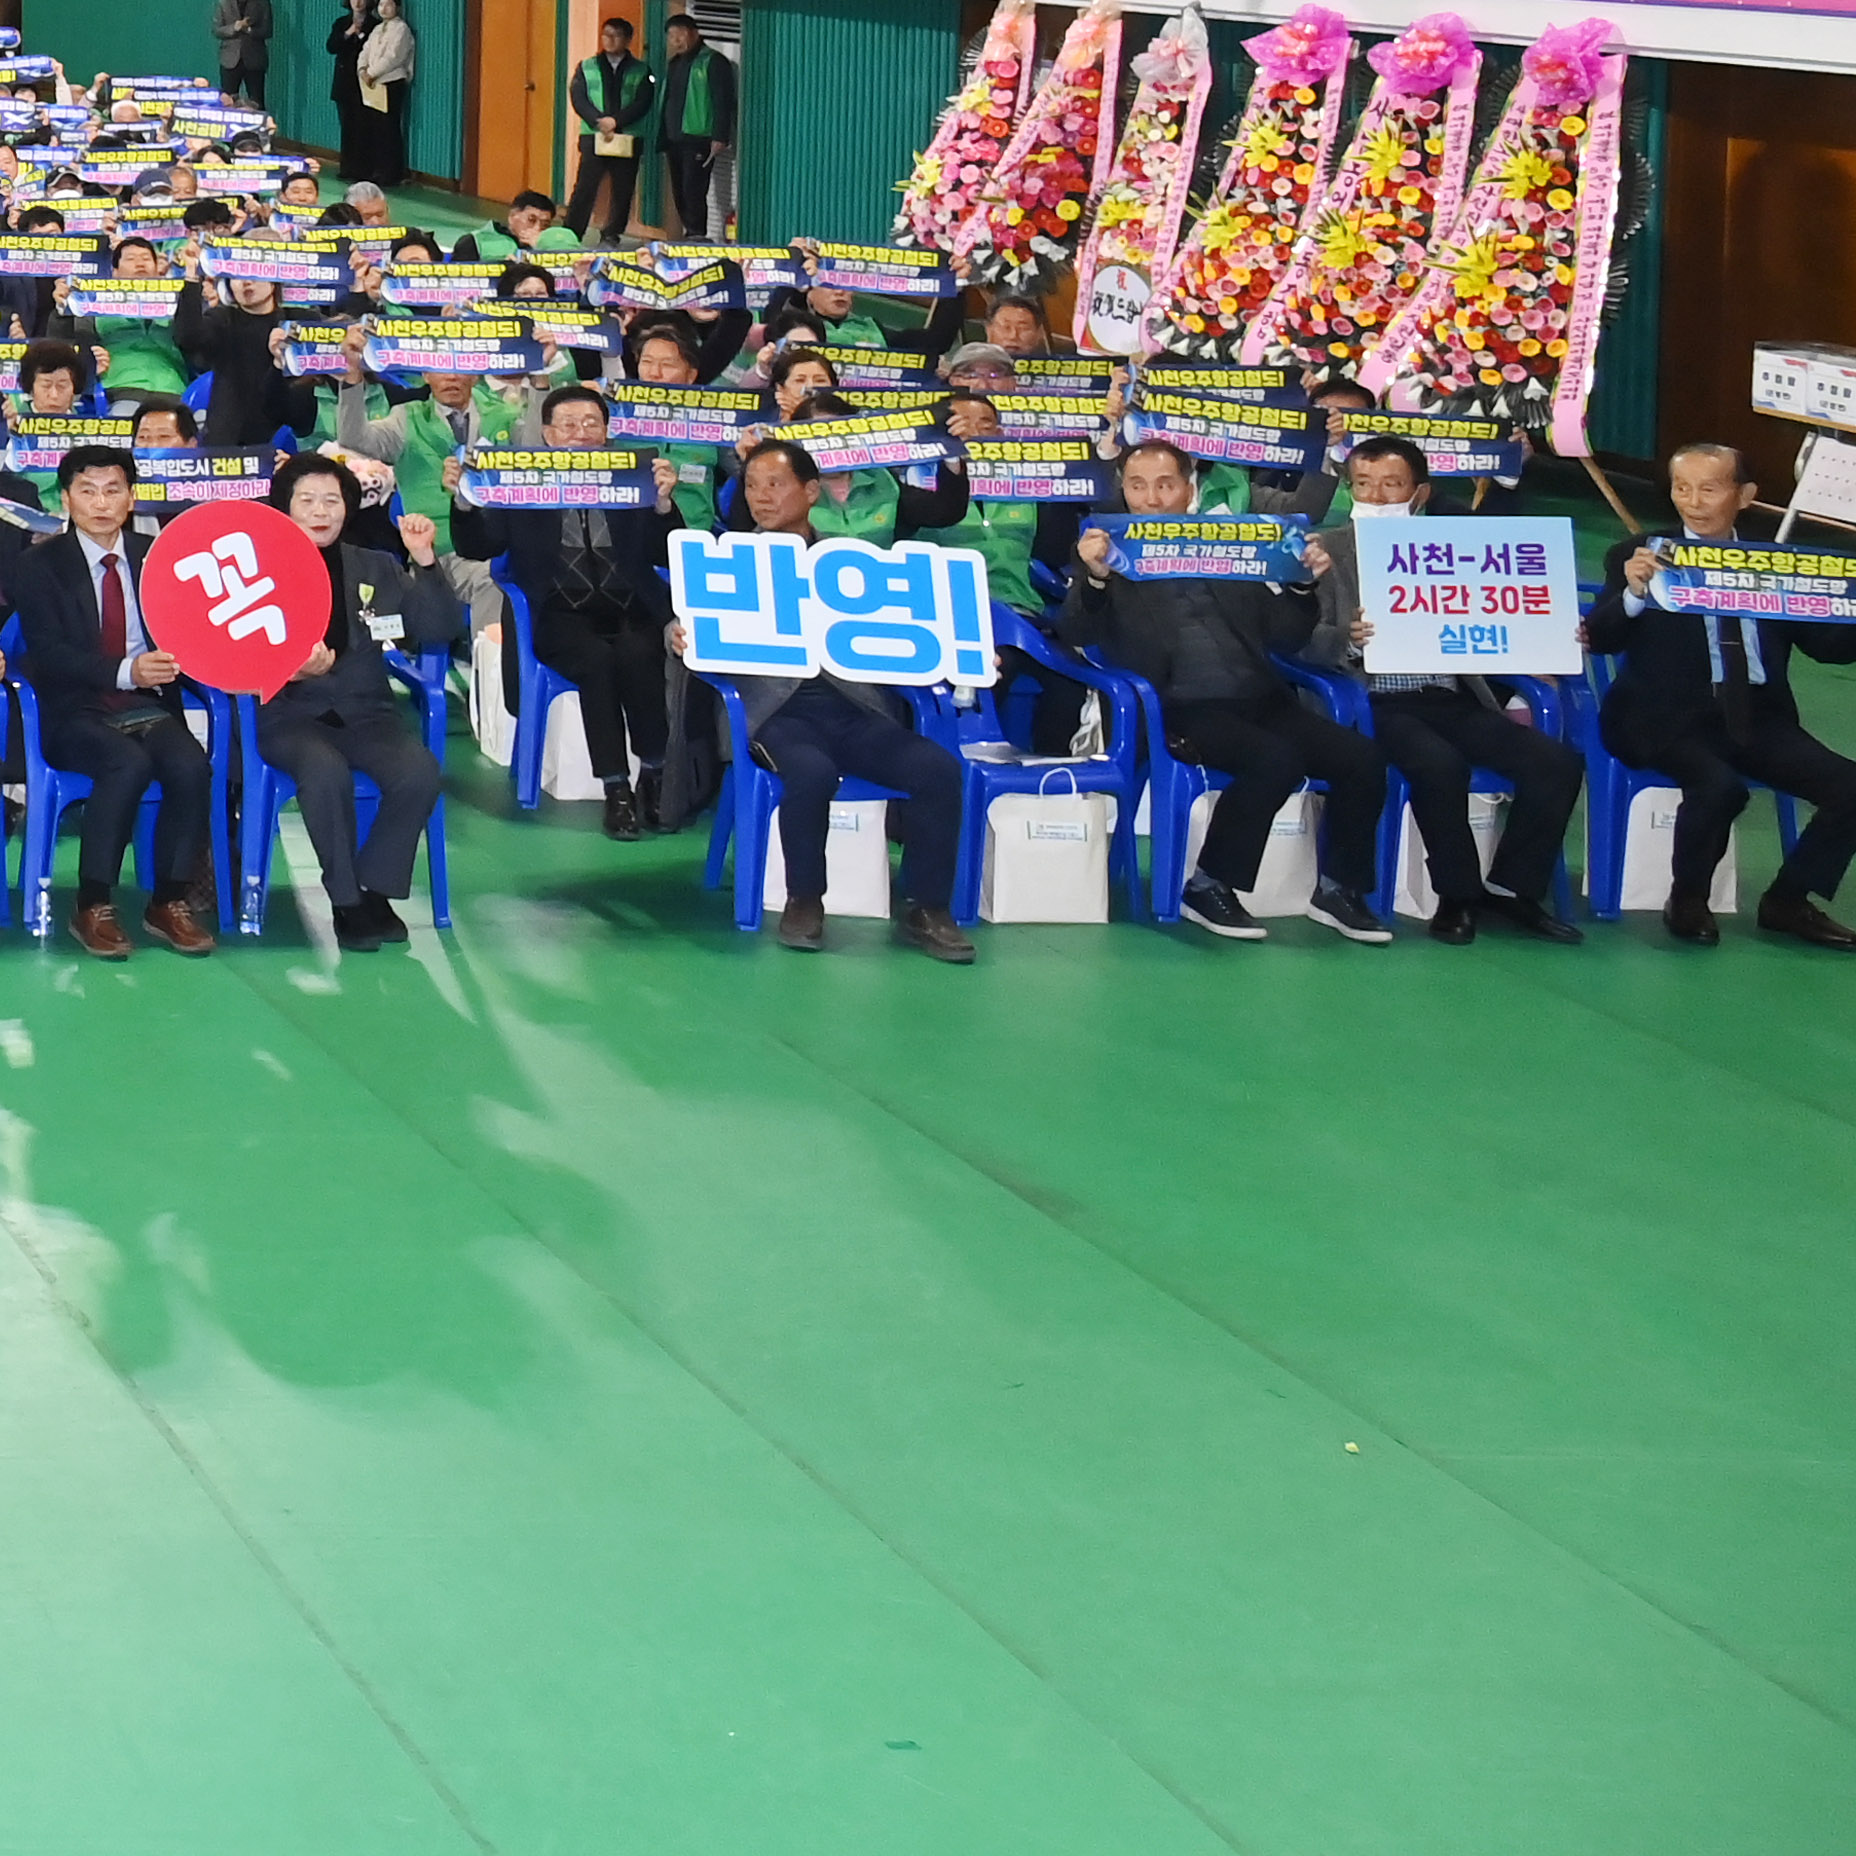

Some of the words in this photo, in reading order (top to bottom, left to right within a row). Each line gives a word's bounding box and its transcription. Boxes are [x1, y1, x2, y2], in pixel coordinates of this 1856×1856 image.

[818, 243, 938, 266] 사천우주항공철도!
[377, 320, 521, 338] 사천우주항공철도!
[398, 338, 433, 351] 제5차
[435, 338, 501, 352] 국가철도망
[377, 352, 452, 368] 구축계획에
[456, 352, 526, 369] 반영하라!
[1148, 369, 1283, 387] 사천우주항공철도!
[617, 386, 759, 410] 사천우주항공철도!
[636, 404, 668, 419] 제5차
[672, 408, 737, 423] 국가철도망
[1142, 392, 1306, 431] 사천우주항공철도!
[689, 422, 738, 441] 반영하
[1166, 416, 1208, 434] 제5차
[212, 458, 241, 475] 건설
[244, 457, 259, 474] 및
[476, 450, 636, 471] 사천우주항공철도!
[500, 470, 536, 485] 제5차
[539, 471, 612, 485] 국가철도망
[476, 486, 557, 504] 구축계획에
[559, 486, 640, 504] 반영하라!
[1125, 522, 1281, 542] 사천우주항공철도!
[1142, 544, 1180, 557] 제5차
[1184, 545, 1257, 559] 국가철도망
[1387, 543, 1547, 576] 사천-서울
[1136, 558, 1199, 573] 구축계획에
[1200, 559, 1266, 575] 반영하라!
[1673, 546, 1856, 579] 사천우주항공철도
[173, 531, 286, 645] 꼭
[1704, 571, 1755, 586] 제5차
[1759, 573, 1848, 594] 국가철도망
[681, 539, 985, 677] 반영!
[1389, 584, 1469, 616] 2시간
[1481, 584, 1551, 615] 30분
[1669, 587, 1782, 612] 구축계획에
[1786, 595, 1856, 617] 반영하
[1439, 624, 1509, 655] 실현!
